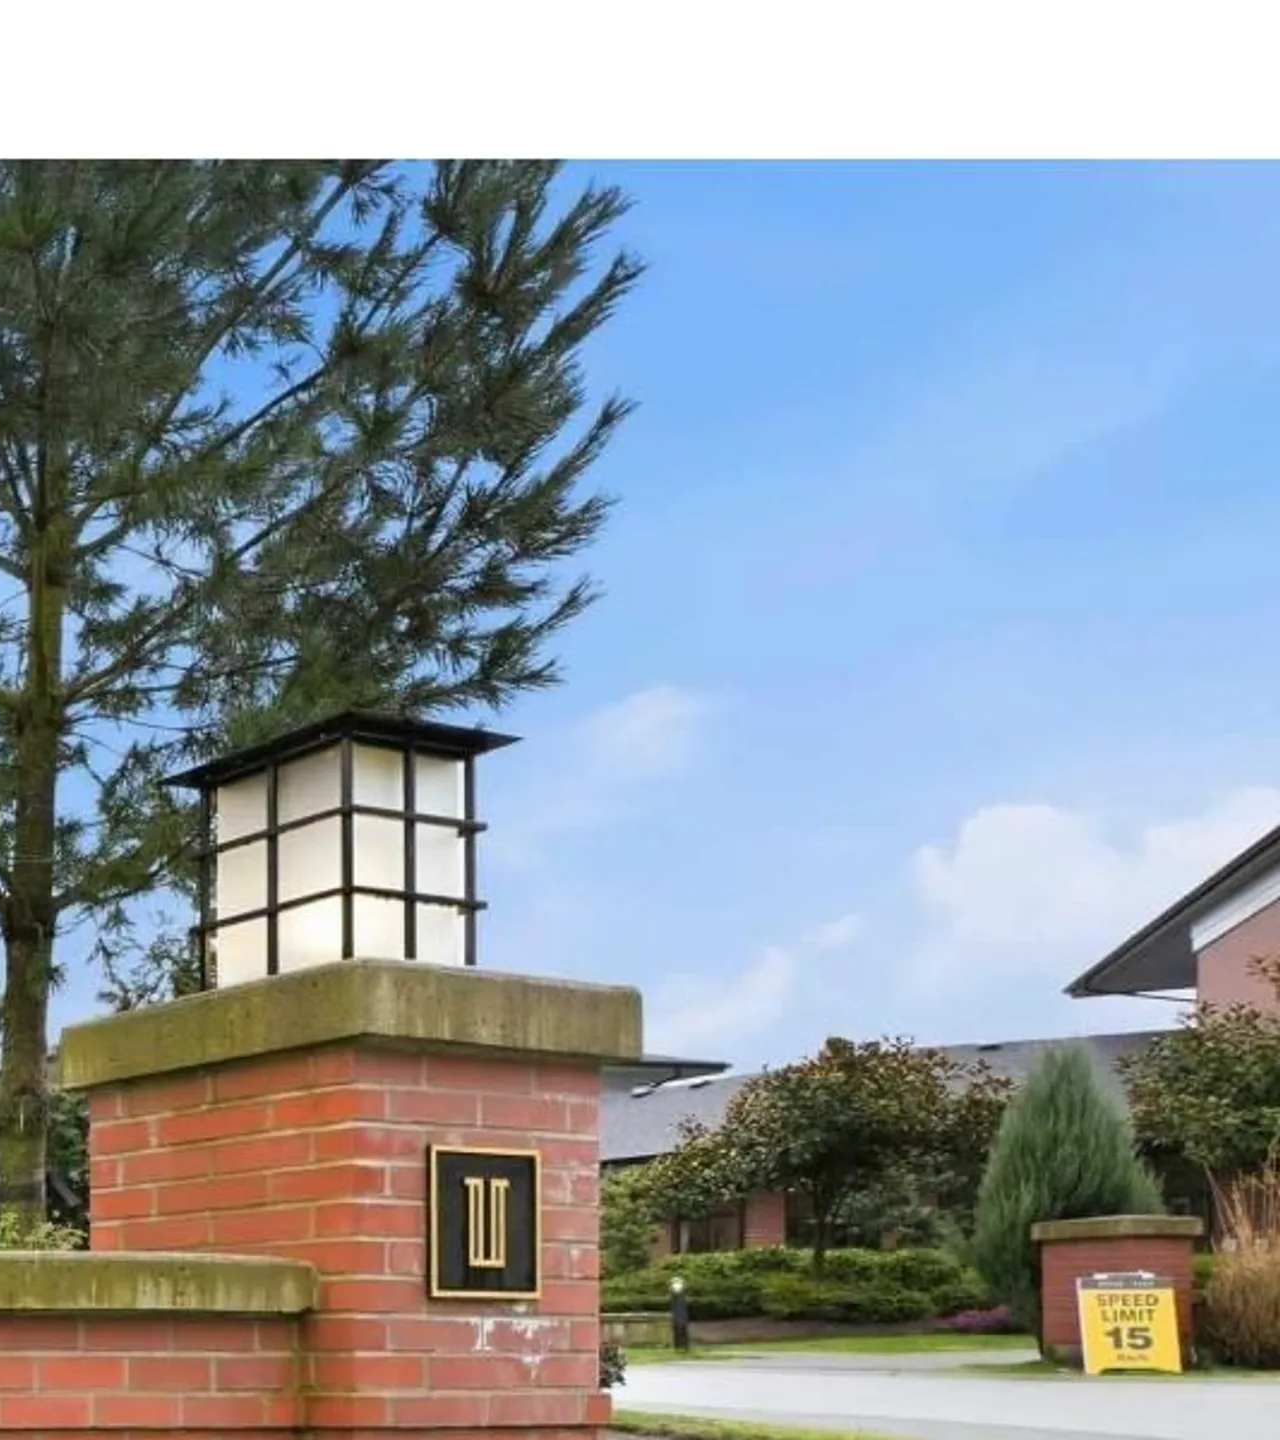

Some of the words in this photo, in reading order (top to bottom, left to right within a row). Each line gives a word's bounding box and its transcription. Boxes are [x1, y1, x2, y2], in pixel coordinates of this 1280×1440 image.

[1095, 1293, 1159, 1307] SPEED
[1101, 1308, 1156, 1322] LIMIT
[1104, 1326, 1153, 1350] 15
